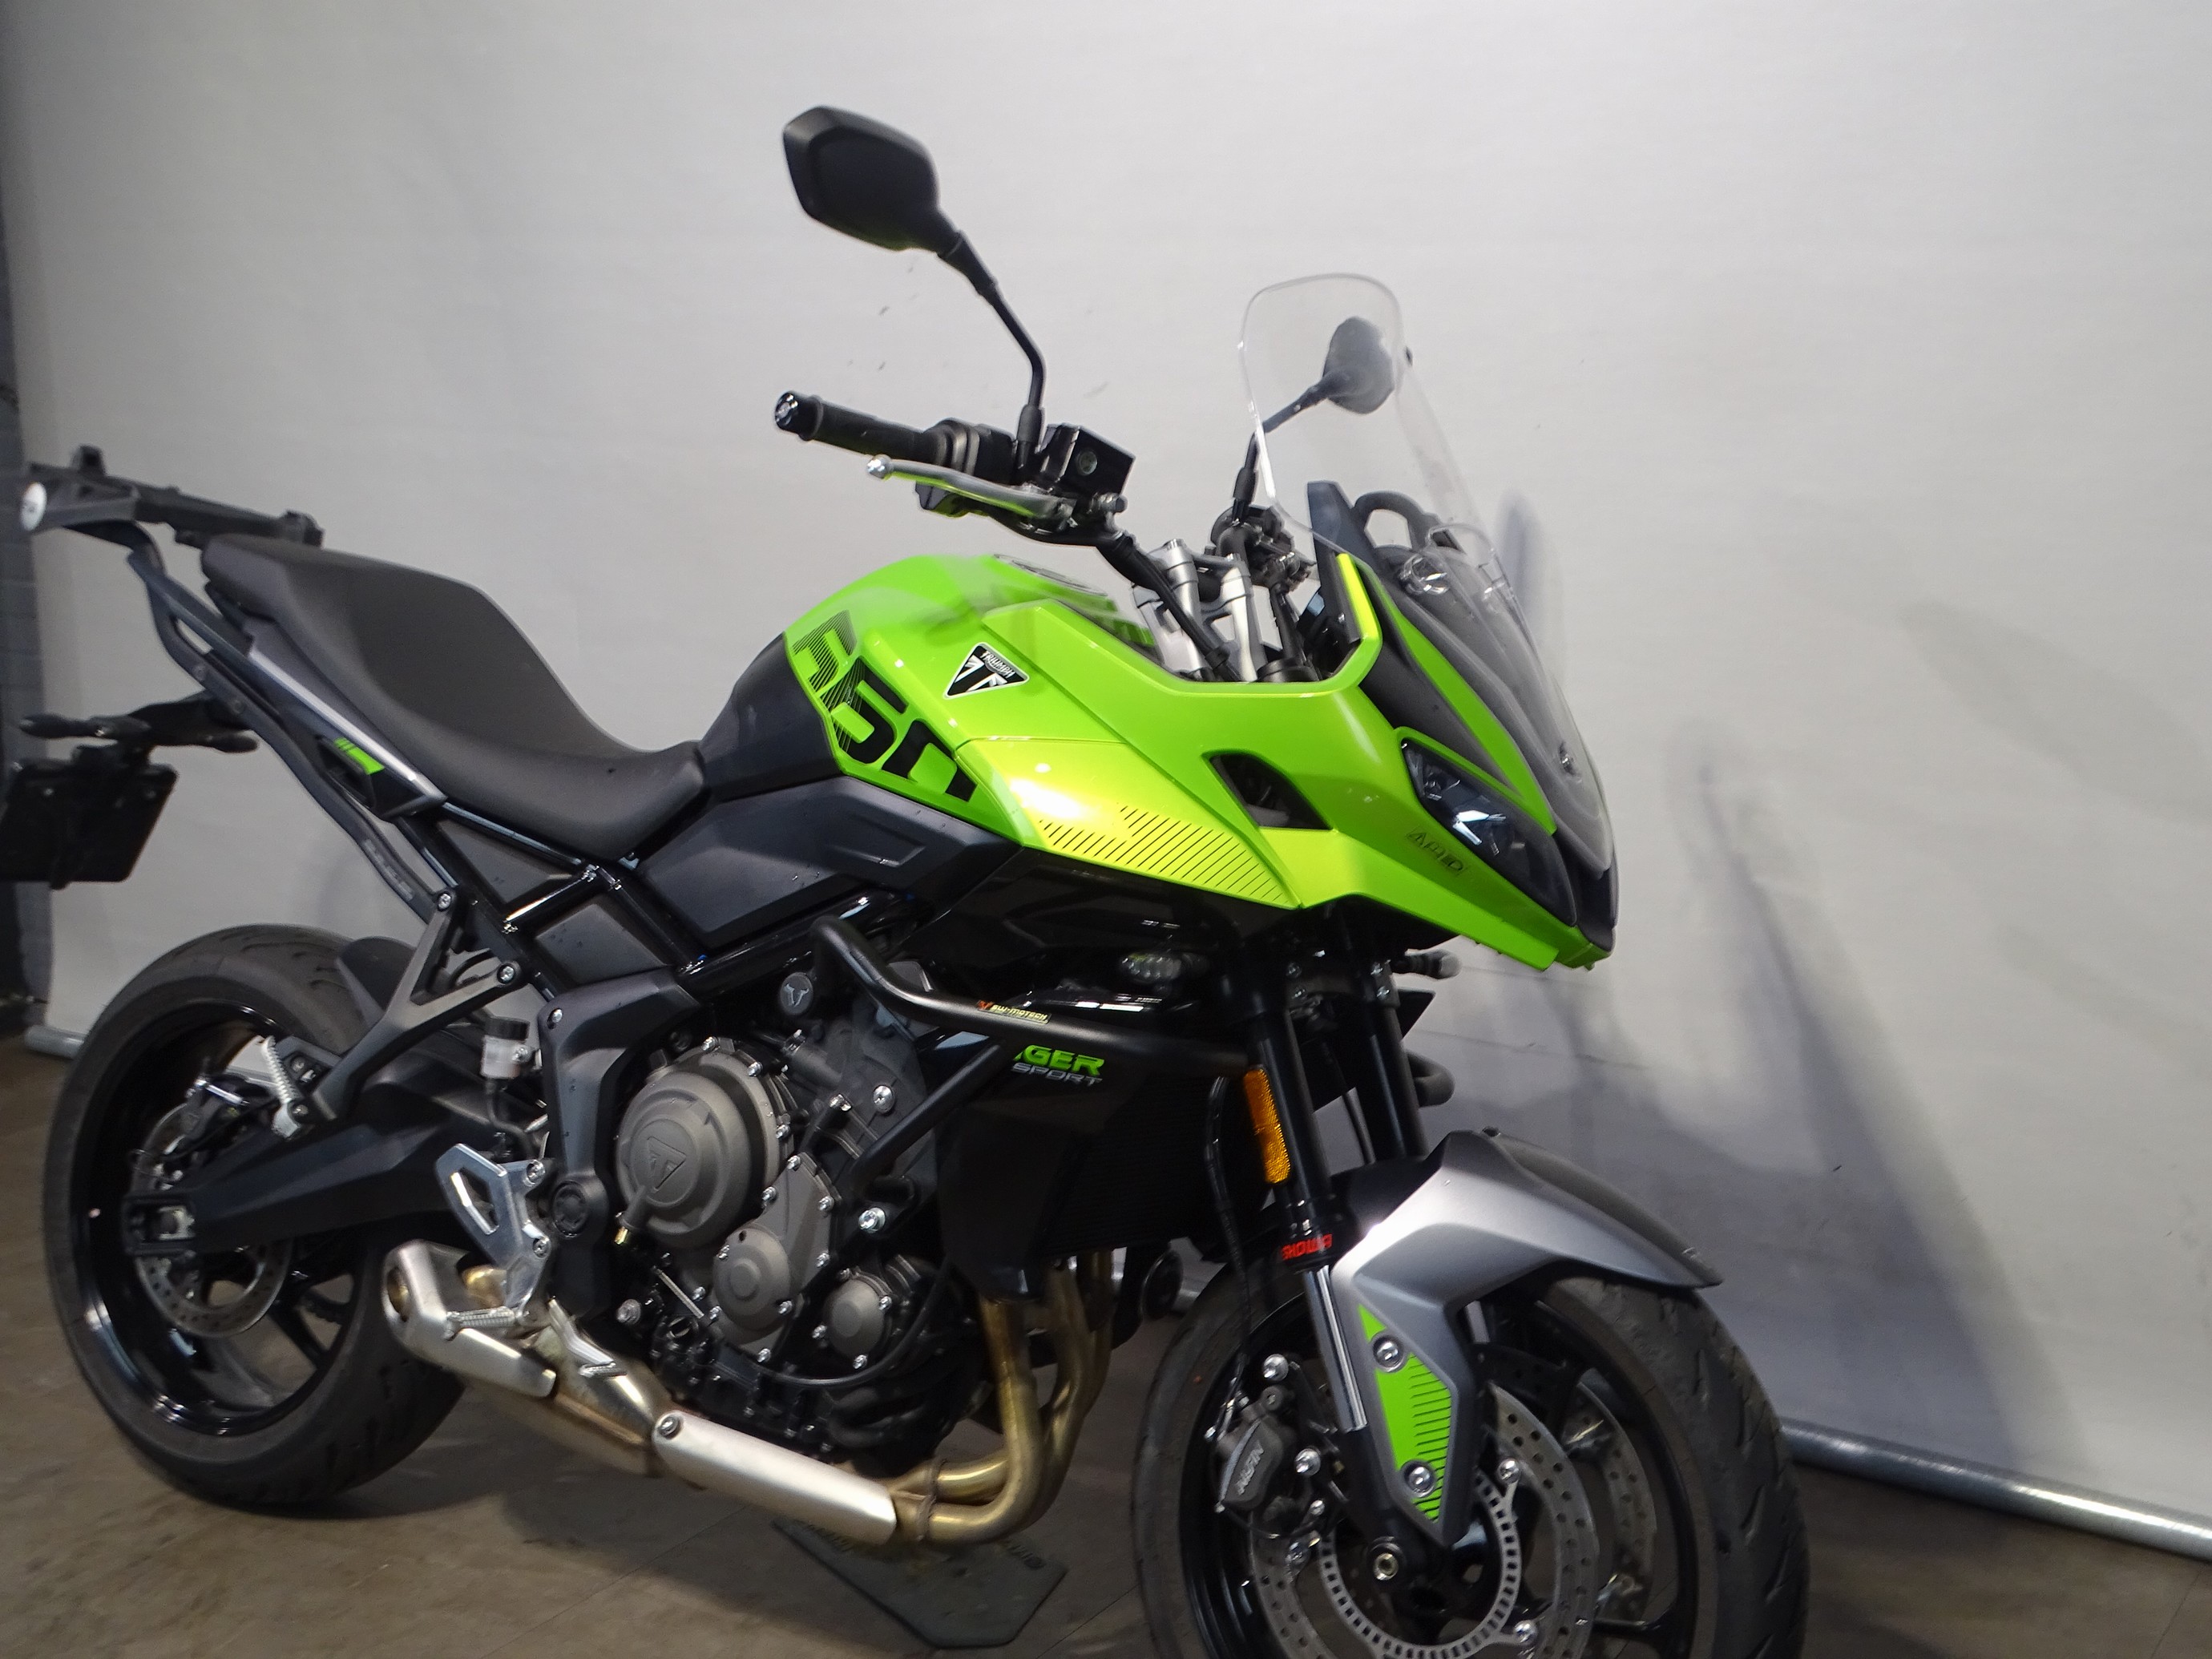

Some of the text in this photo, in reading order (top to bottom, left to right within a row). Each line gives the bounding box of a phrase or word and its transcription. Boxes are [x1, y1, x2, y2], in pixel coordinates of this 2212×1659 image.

[979, 650, 1015, 678] TRIUMPH
[1011, 1062, 1103, 1087] SPORT
[1013, 1044, 1105, 1077] GER
